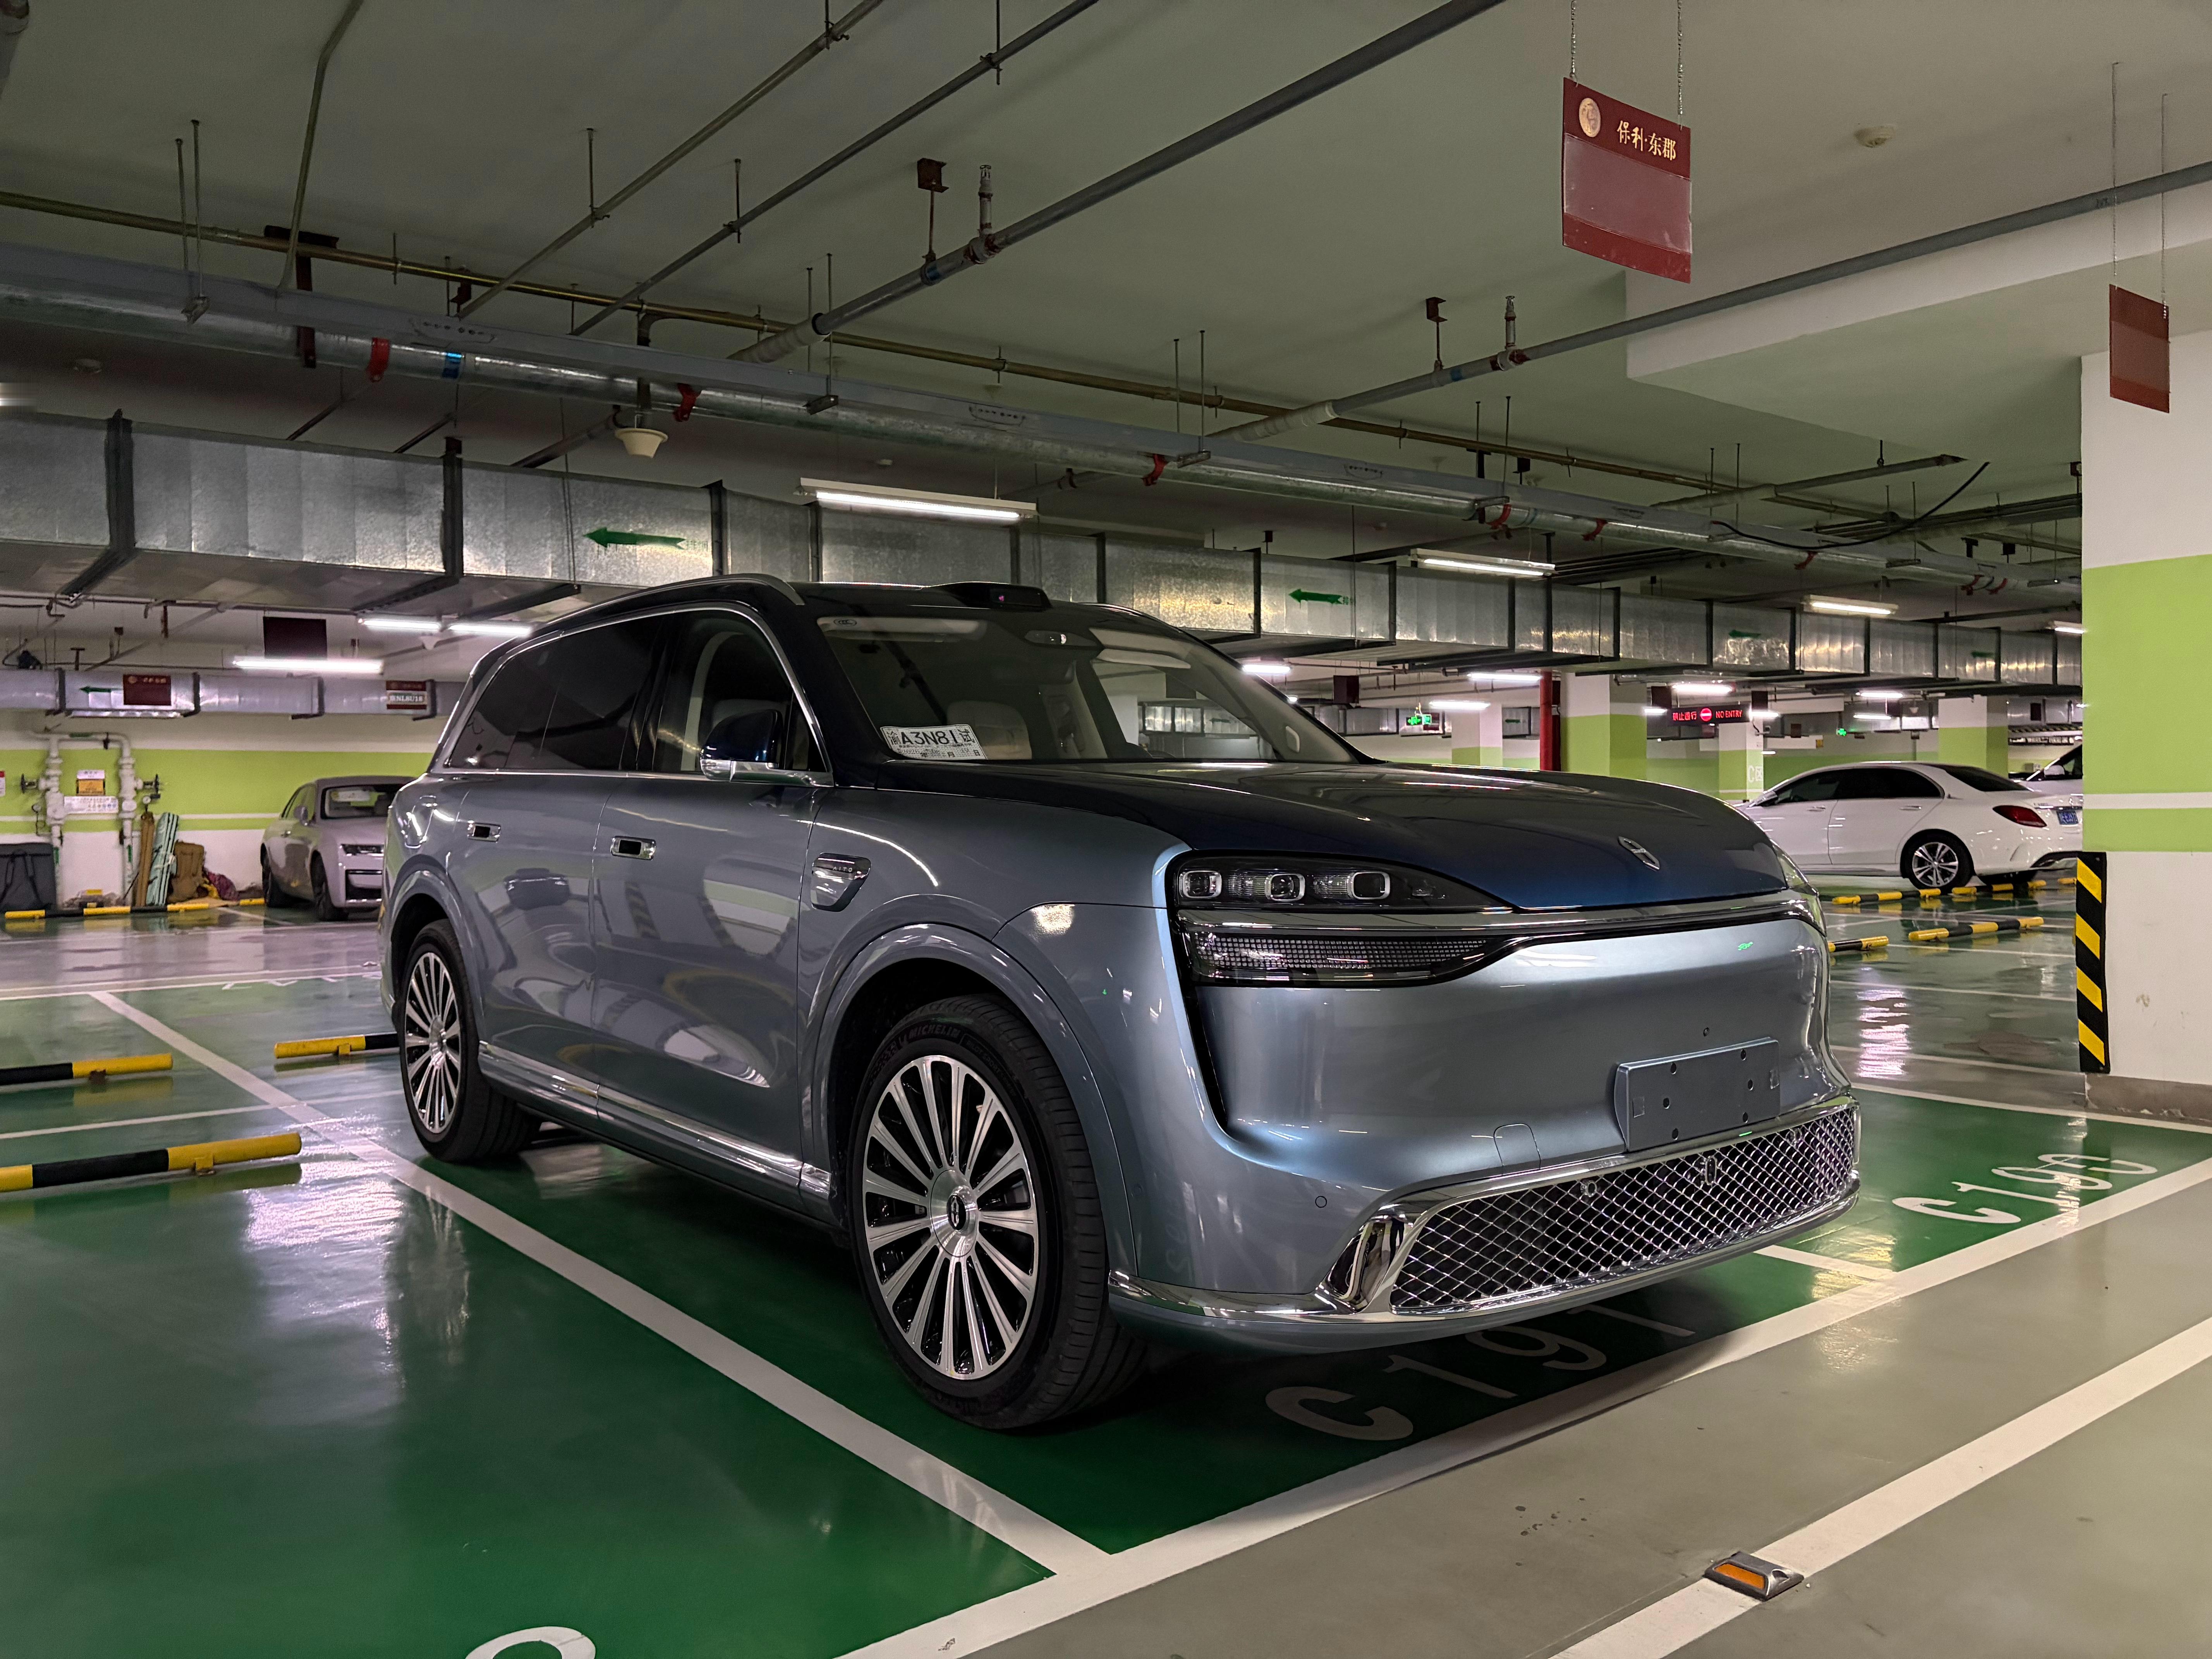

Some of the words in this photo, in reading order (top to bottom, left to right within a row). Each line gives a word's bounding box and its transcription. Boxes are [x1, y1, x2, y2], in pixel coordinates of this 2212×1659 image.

[1617, 120, 1676, 160] 保利·东郡
[1673, 711, 1697, 721] 禁止通行
[909, 1025, 961, 1038] MICHELIN
[1265, 1306, 1696, 1441] C191
